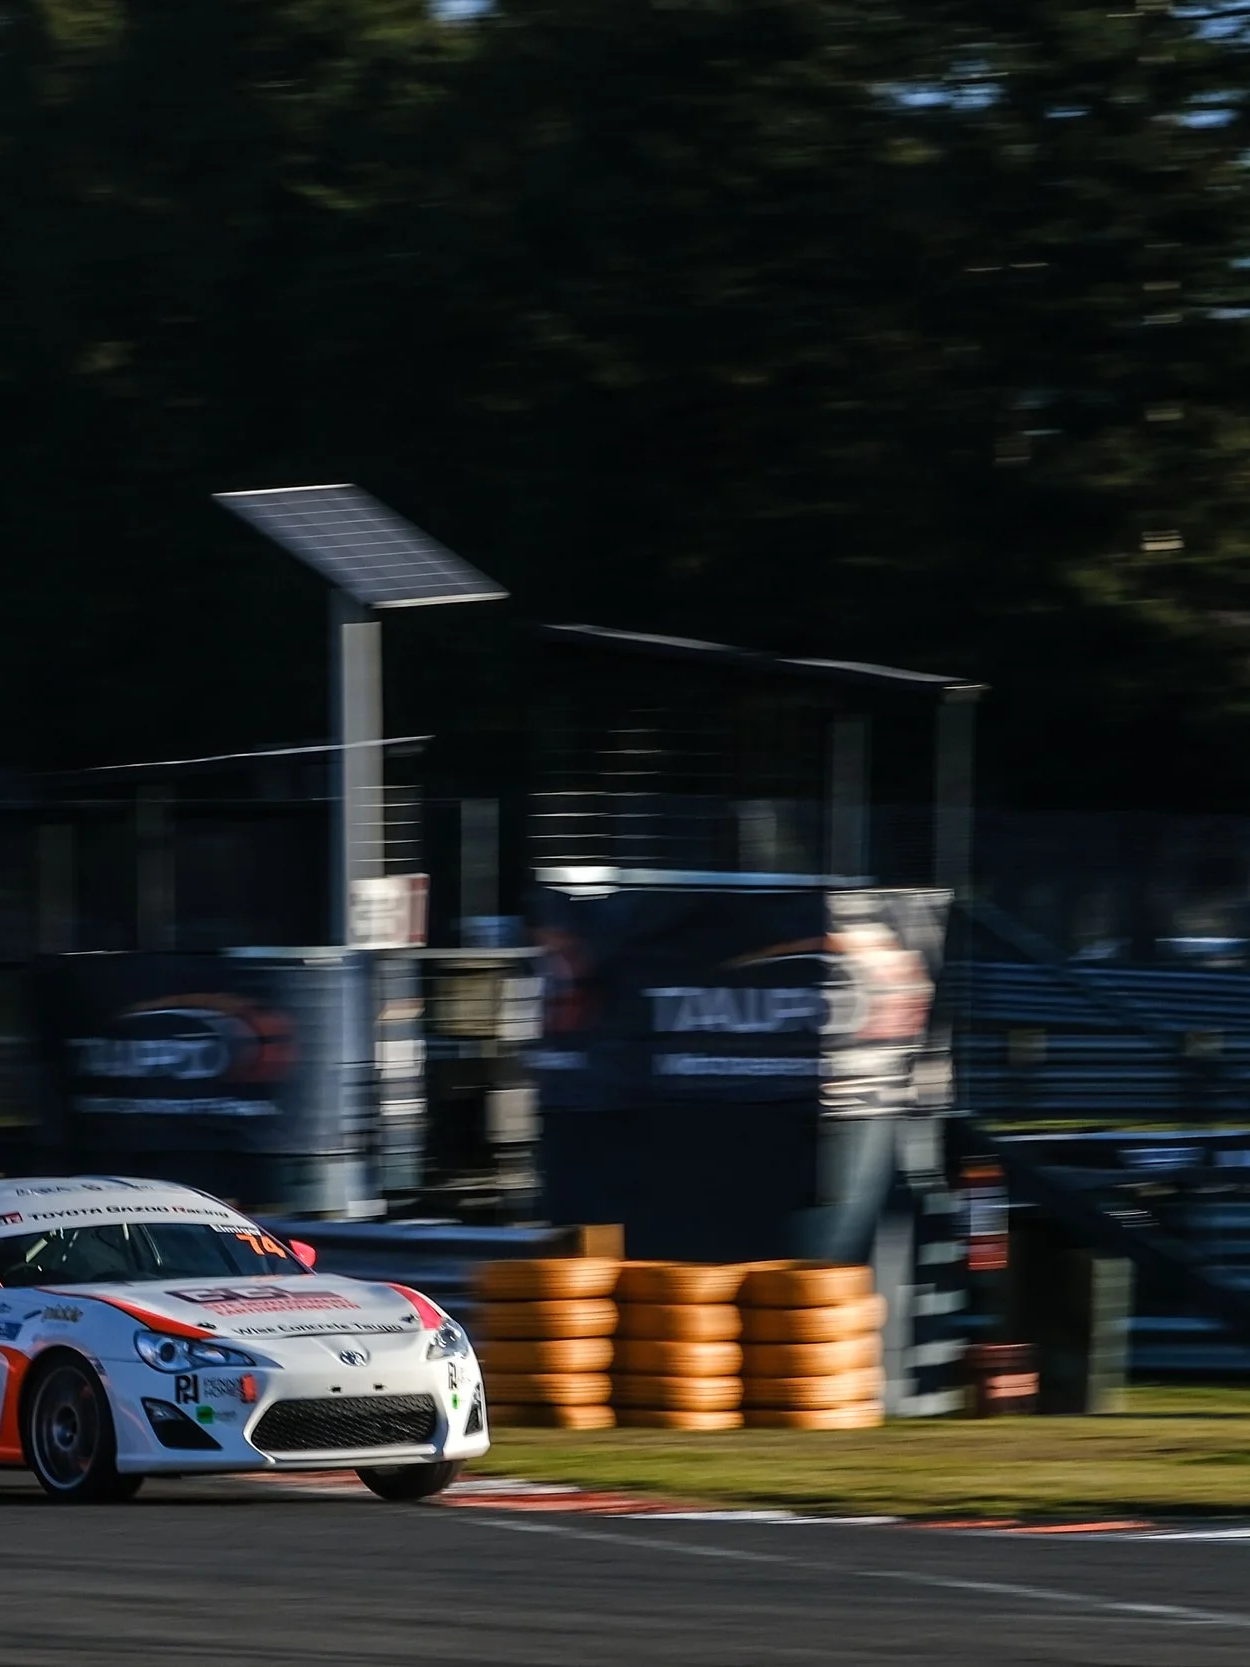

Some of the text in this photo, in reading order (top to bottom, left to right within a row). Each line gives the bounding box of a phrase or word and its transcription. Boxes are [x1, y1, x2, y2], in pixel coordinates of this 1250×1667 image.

[31, 1204, 230, 1221] TOYOTA GAZOO Racing
[236, 1233, 287, 1259] 74
[276, 1321, 350, 1334] Concrete
